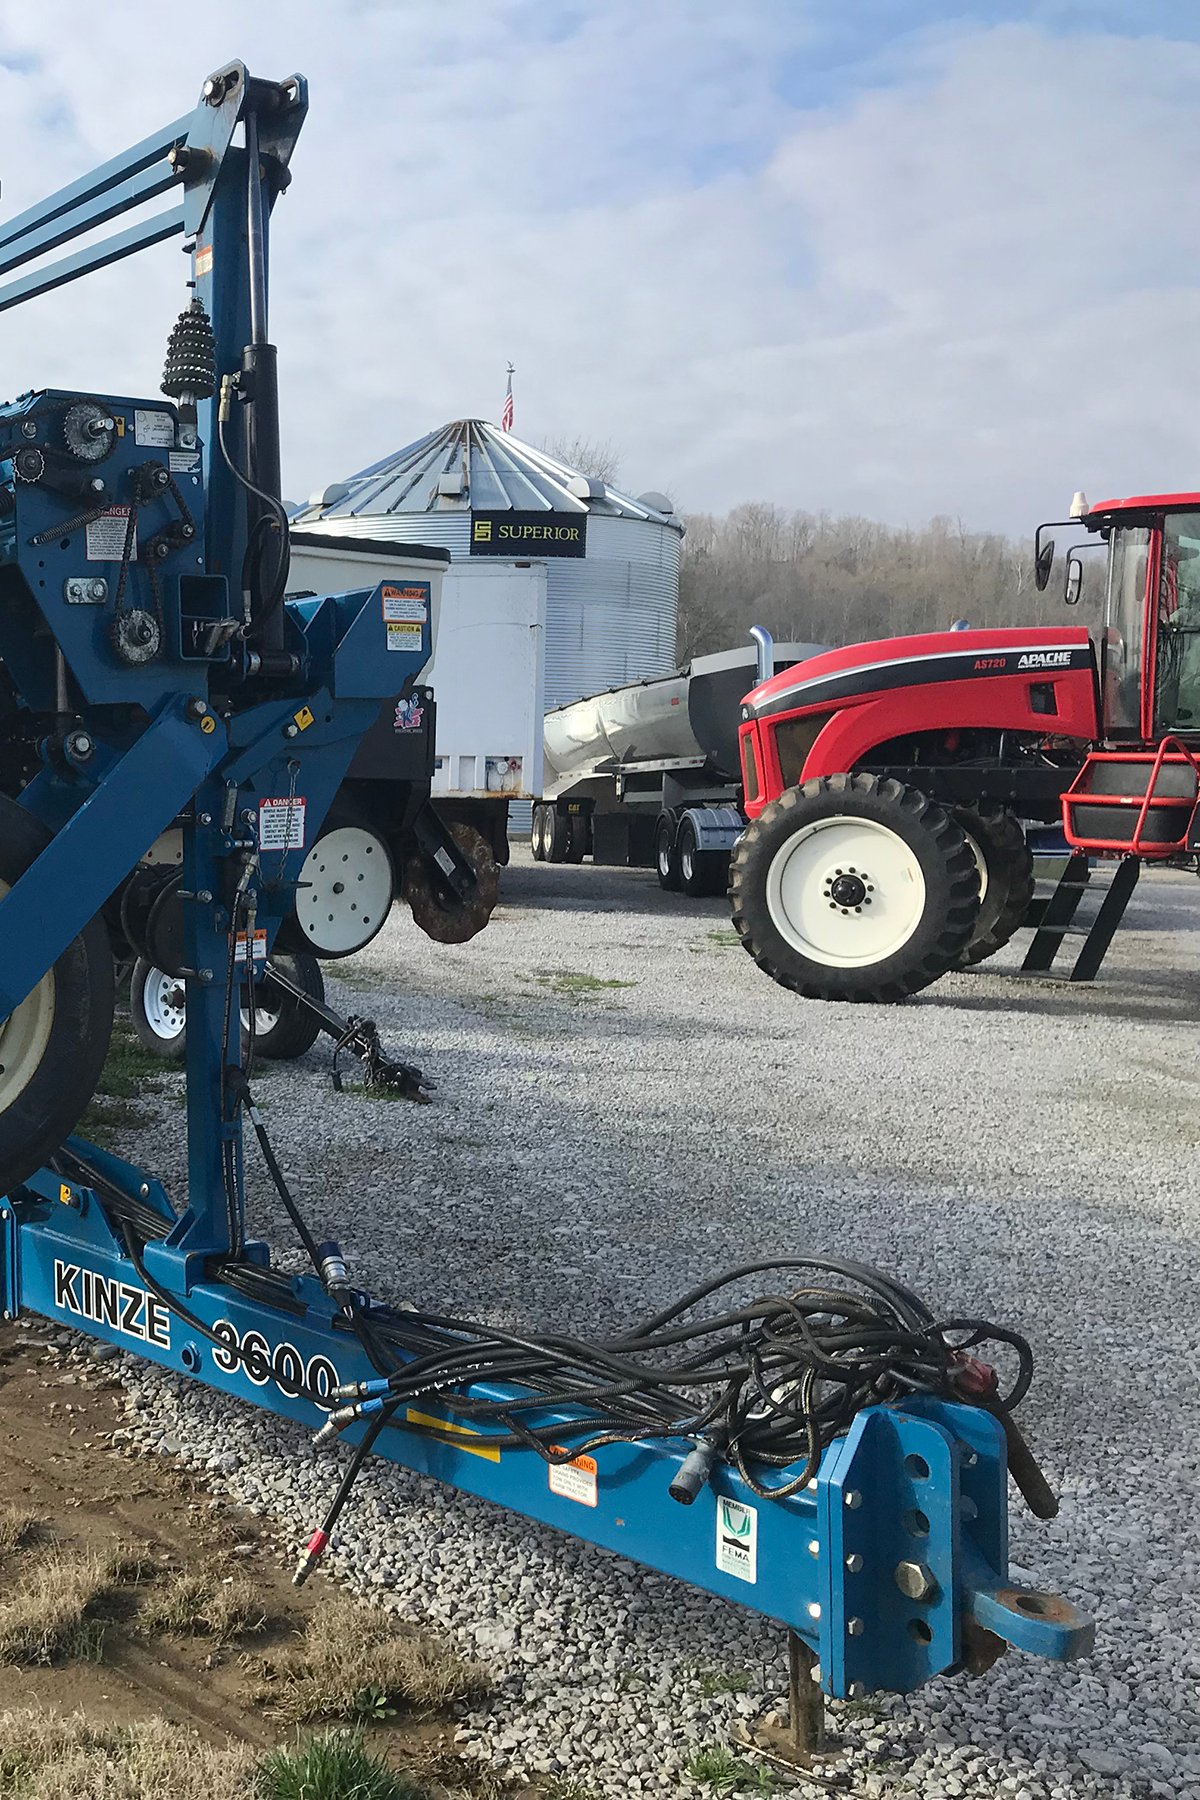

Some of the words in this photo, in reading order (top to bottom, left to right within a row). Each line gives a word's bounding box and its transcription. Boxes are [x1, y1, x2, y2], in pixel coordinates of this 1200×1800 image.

[498, 525, 580, 541] SUPERIOR
[974, 658, 1006, 670] AS720
[1017, 651, 1072, 665] APACHE
[54, 1258, 171, 1350] KINZE
[211, 1318, 340, 1412] 3600
[722, 1499, 751, 1515] MEMBER
[722, 1545, 750, 1562] FEMA
